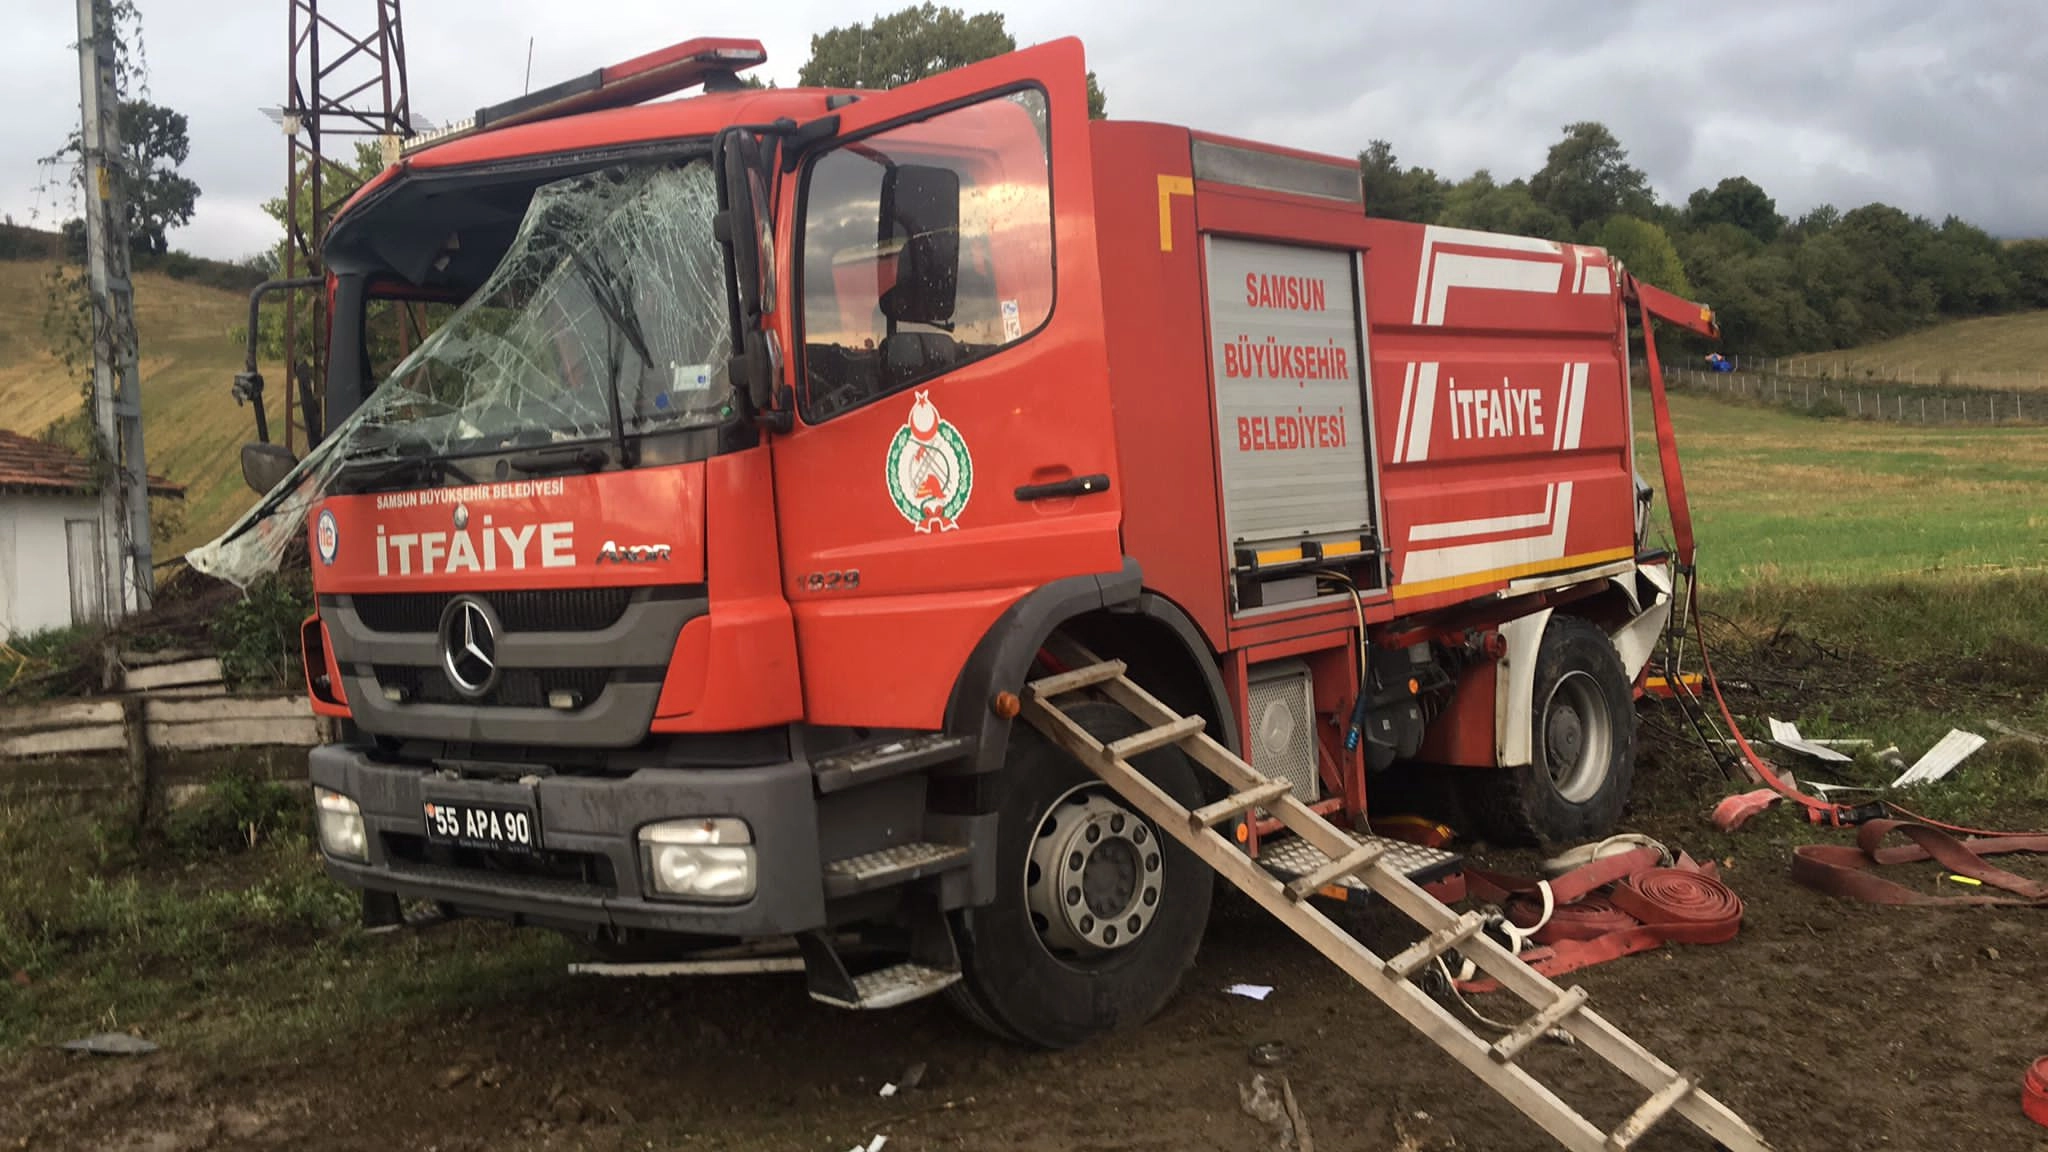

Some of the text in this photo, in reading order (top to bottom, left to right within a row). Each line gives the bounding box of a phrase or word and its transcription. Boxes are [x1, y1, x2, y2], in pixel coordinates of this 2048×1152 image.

[1245, 272, 1326, 312] SAMSUN
[1224, 335, 1349, 389] BÜYÜKŞEHİR
[1237, 405, 1346, 451] BELEDİYESİ
[1449, 376, 1544, 440] İTFAİYE
[377, 477, 564, 510] SAMSUN BÜYÜKŞEHİR BELEDİYESİ
[376, 515, 576, 577] İTFAİYE
[435, 806, 529, 844] 55 APA 90
